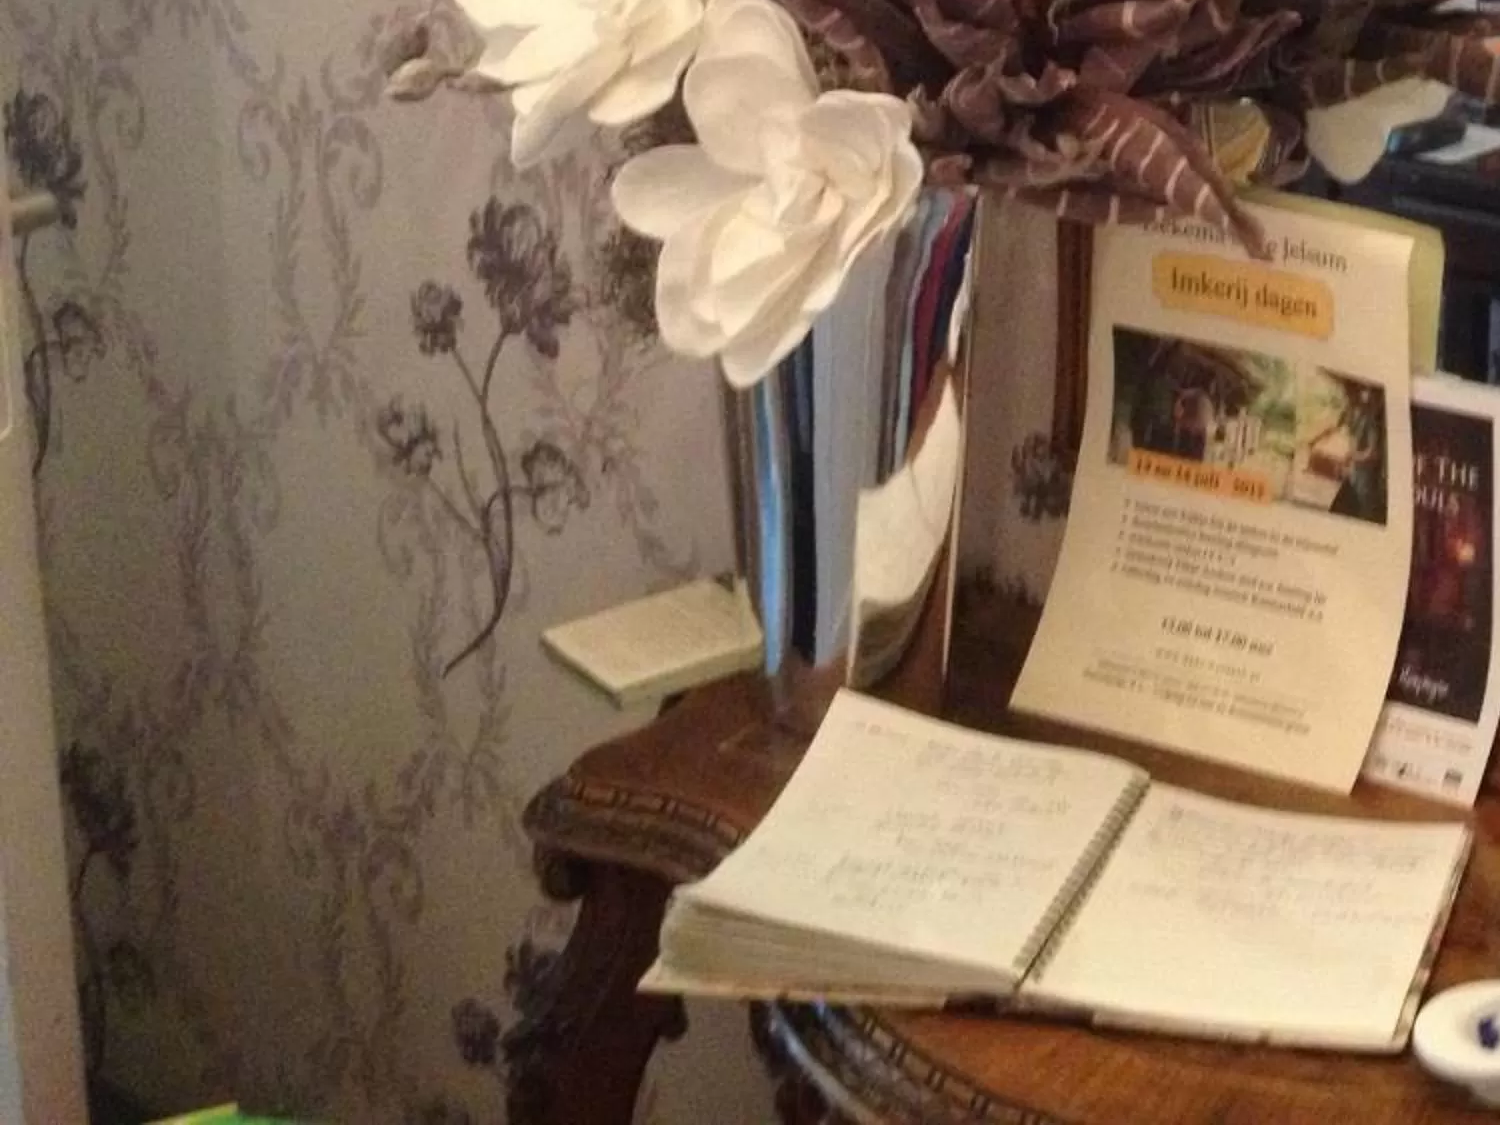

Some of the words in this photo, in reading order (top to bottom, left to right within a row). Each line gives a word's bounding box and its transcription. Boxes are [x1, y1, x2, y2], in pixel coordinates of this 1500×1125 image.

[1170, 268, 1251, 309] Imkerij
[1254, 286, 1319, 320] dagen
[1437, 458, 1480, 489] THE
